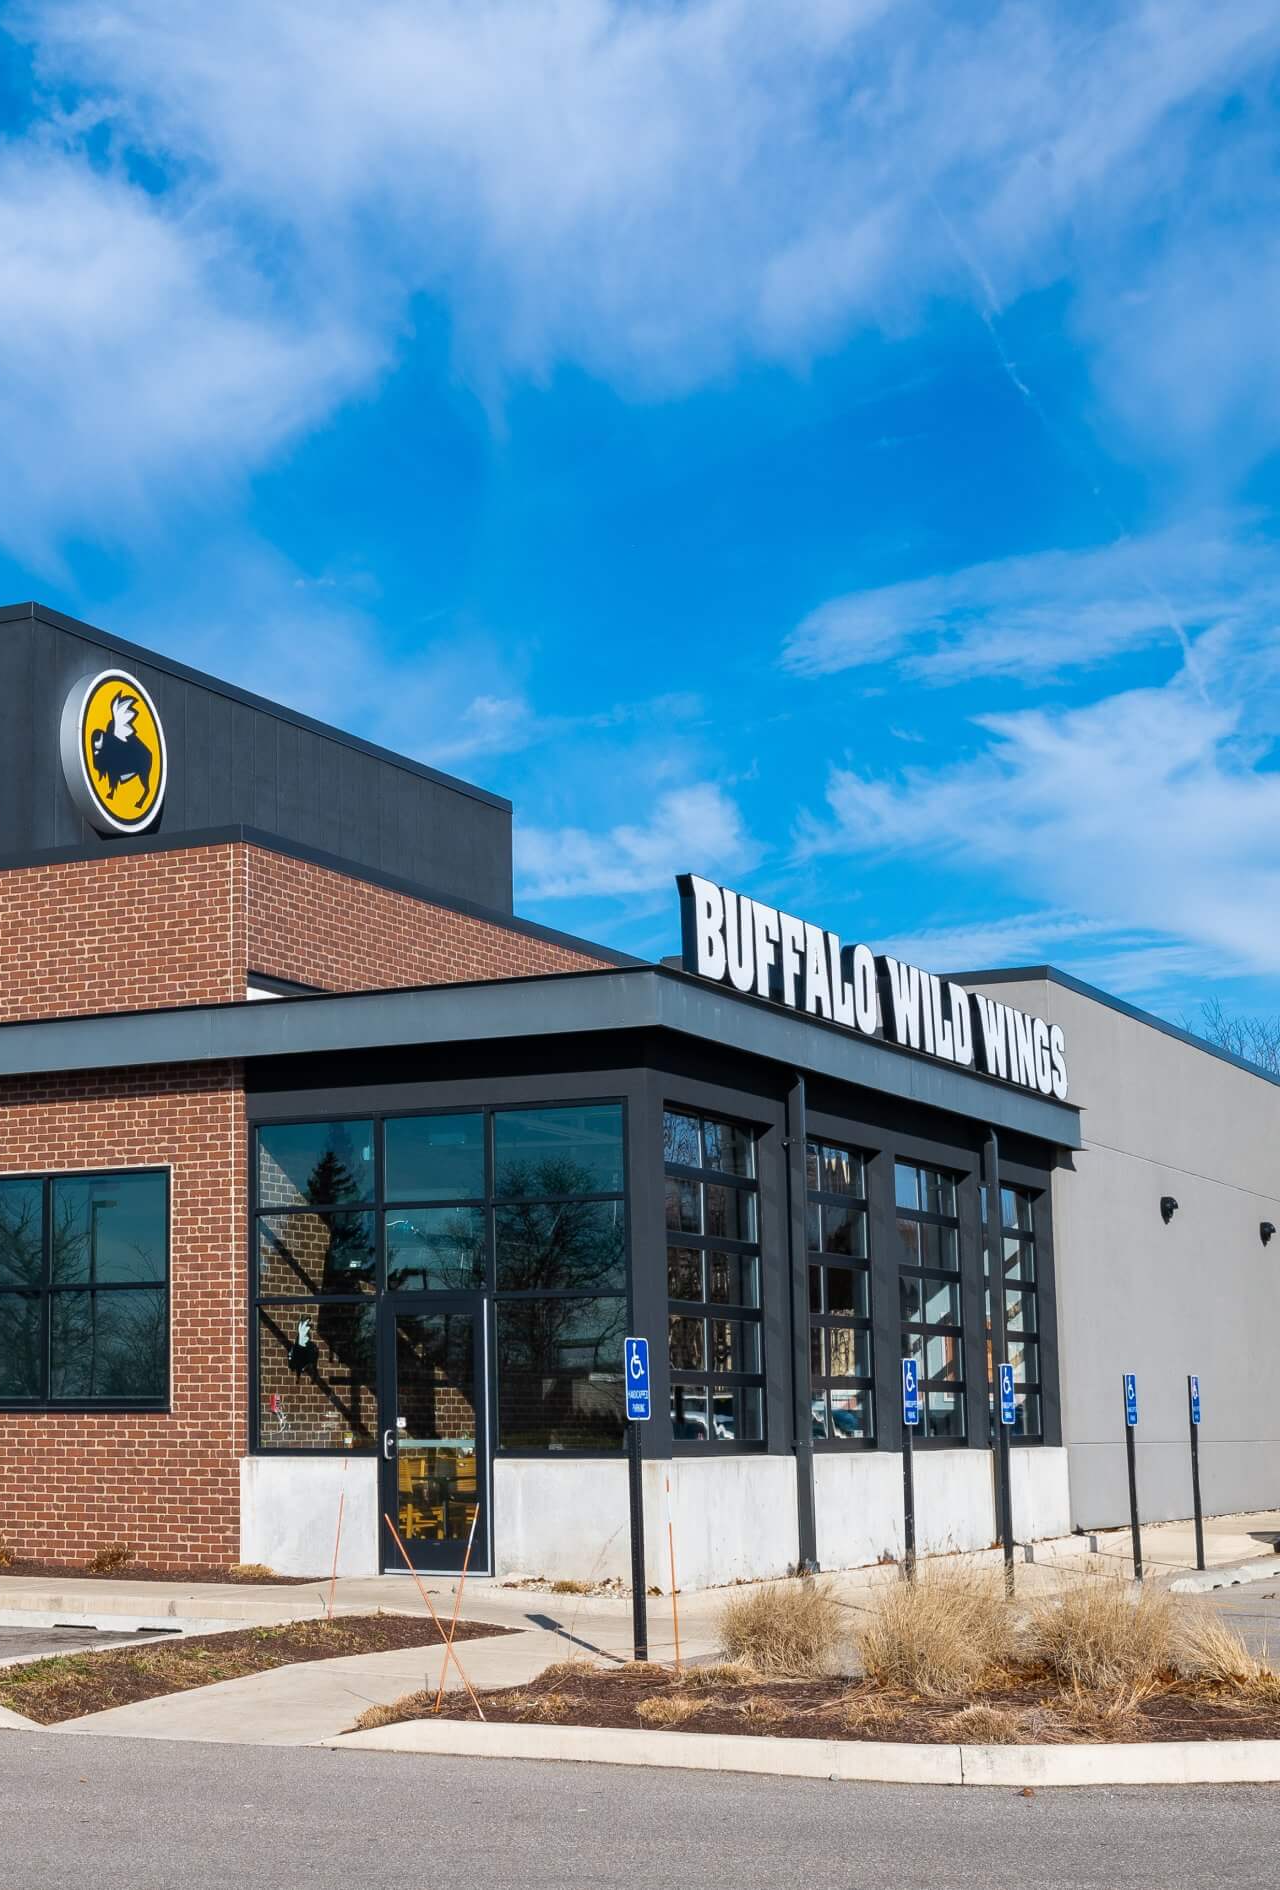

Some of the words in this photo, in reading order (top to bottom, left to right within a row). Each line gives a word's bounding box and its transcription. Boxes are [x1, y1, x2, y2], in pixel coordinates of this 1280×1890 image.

[688, 873, 878, 1035] BUFFALO
[883, 954, 974, 1066] WILD
[974, 992, 1069, 1101] WINGS
